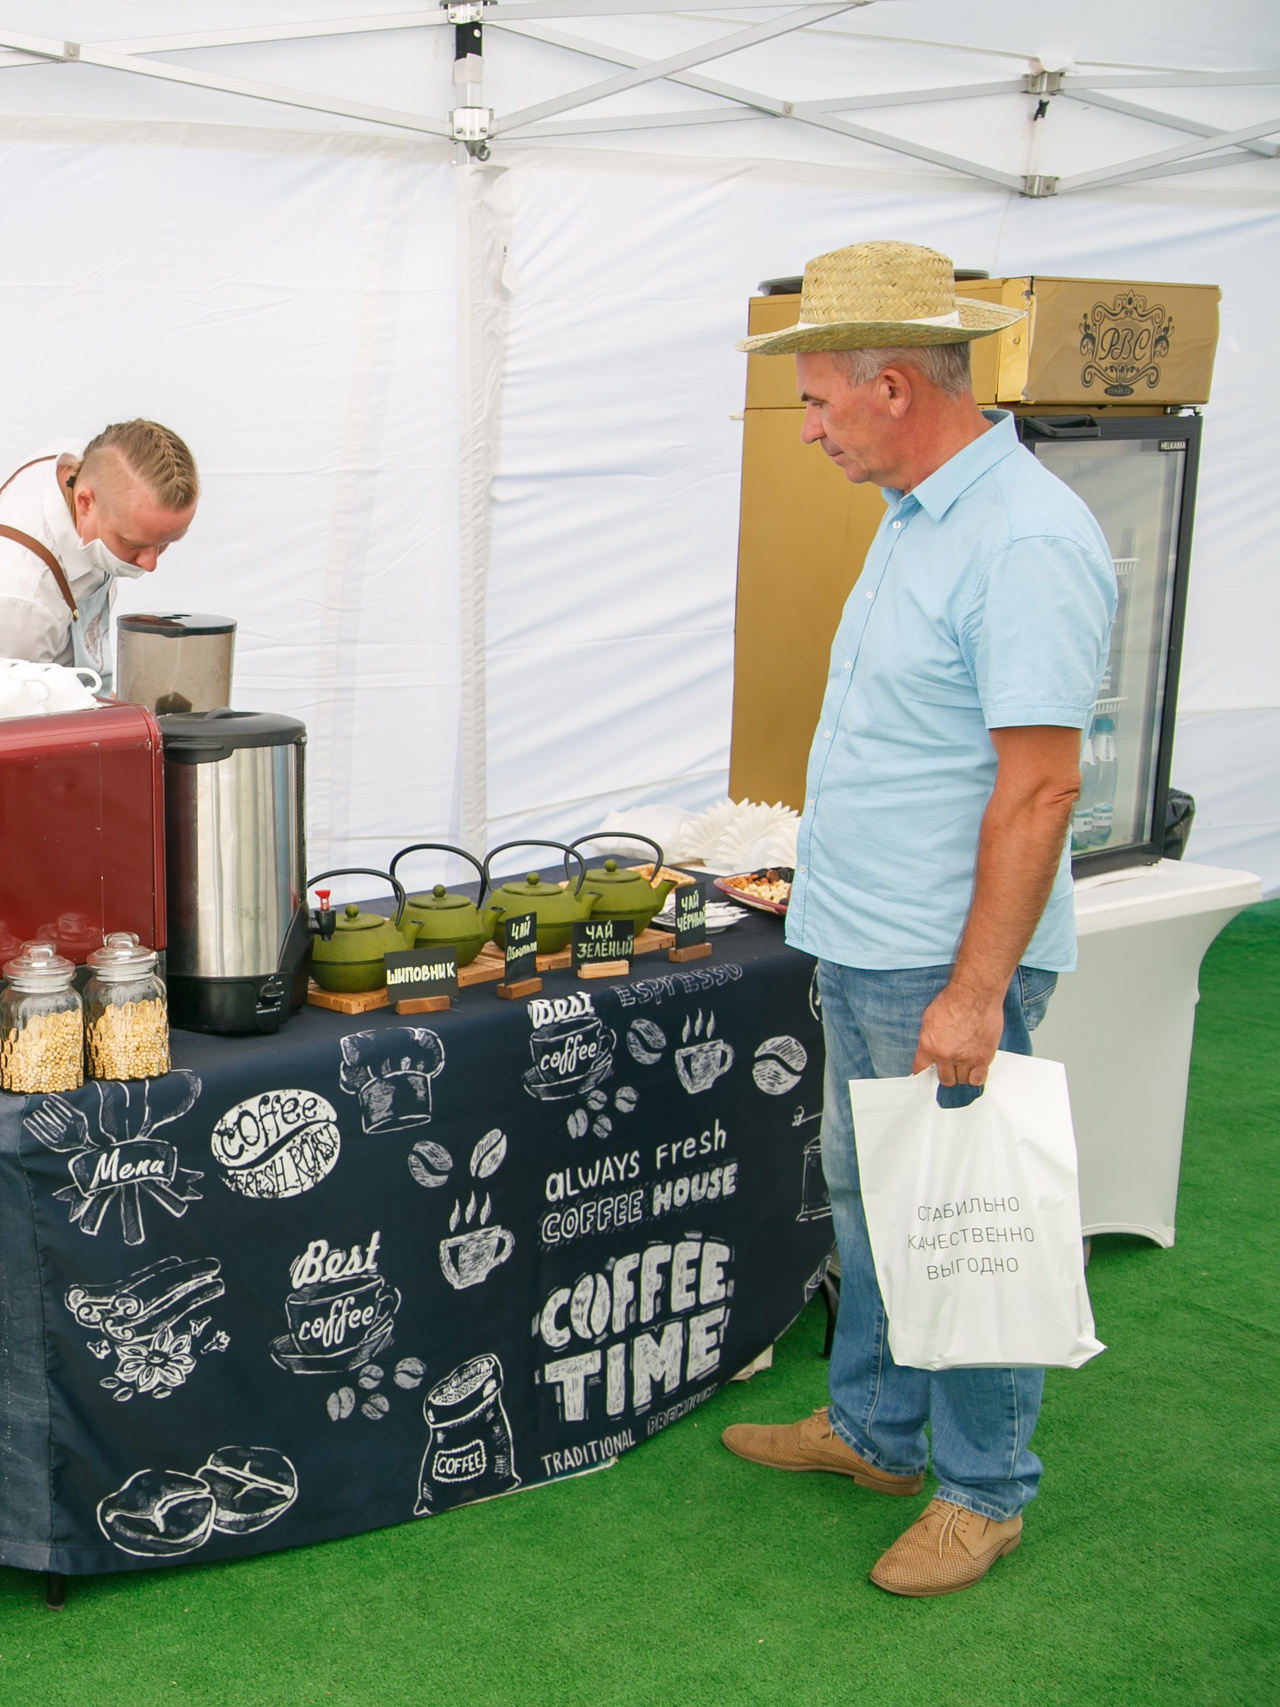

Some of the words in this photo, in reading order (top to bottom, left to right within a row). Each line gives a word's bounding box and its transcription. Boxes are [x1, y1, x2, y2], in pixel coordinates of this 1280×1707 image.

[1161, 441, 1186, 450] HELKAMA
[585, 920, 613, 940] ЧАЙ
[386, 961, 456, 985] ШИПОВНИК
[528, 991, 595, 1029] Best
[540, 1034, 598, 1075] coffee
[94, 1153, 166, 1188] Menu
[542, 1189, 644, 1243] COFFEE
[652, 1162, 738, 1216] HOUSE
[917, 1196, 1020, 1222] СТАБИЛЬНО
[907, 1227, 1035, 1252] КАЧЕСТВЕННО
[292, 1231, 381, 1290] Best
[927, 1257, 1019, 1280] ВЫГОДНО
[540, 1241, 731, 1348] COFFEE
[298, 1296, 375, 1347] coffee
[544, 1305, 726, 1421] TIME
[437, 1449, 484, 1475] COFFEE
[541, 1428, 636, 1477] TRADITIONAL
